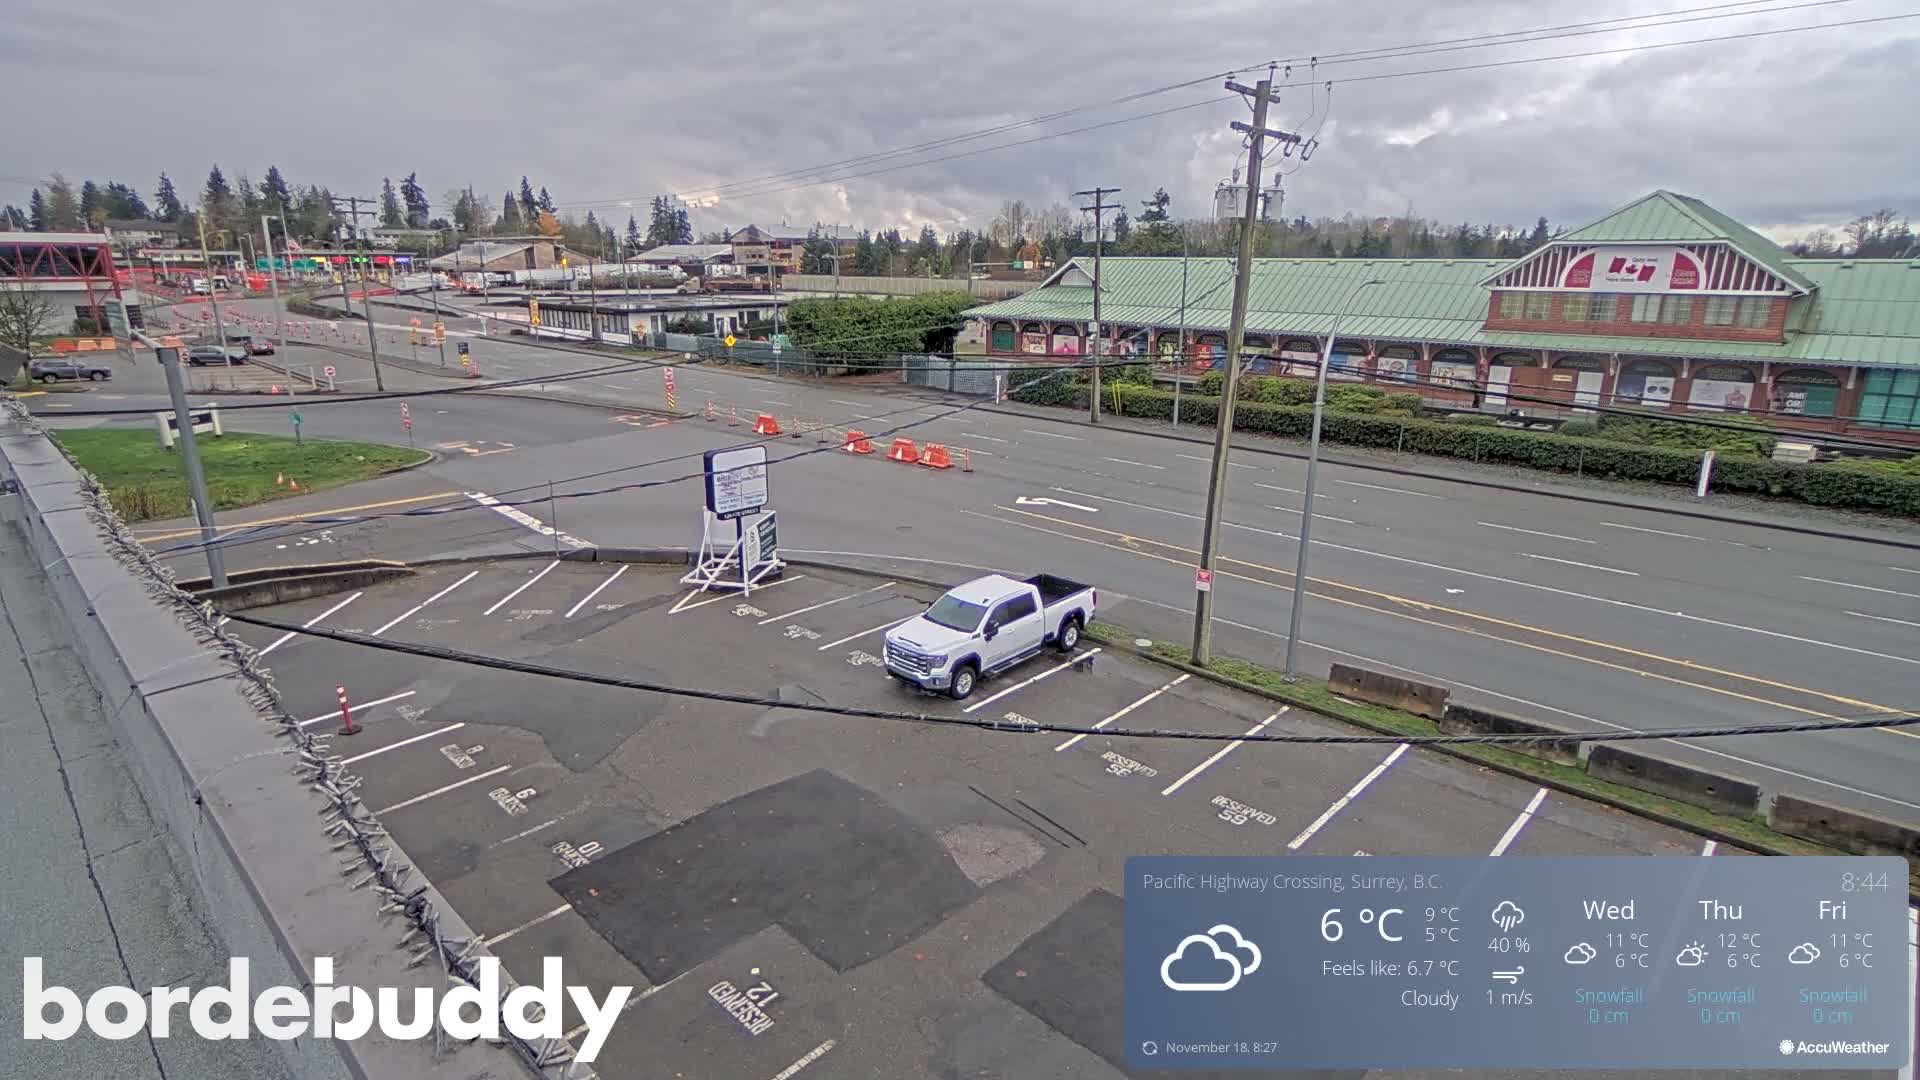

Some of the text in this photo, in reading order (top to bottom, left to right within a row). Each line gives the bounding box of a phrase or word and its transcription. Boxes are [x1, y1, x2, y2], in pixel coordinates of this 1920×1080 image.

[1101, 751, 1158, 777] RESERVED
[1211, 795, 1277, 825] RESERVED
[1218, 809, 1249, 825] 59
[746, 981, 779, 1007] 12
[708, 981, 776, 1036] RESERVED
